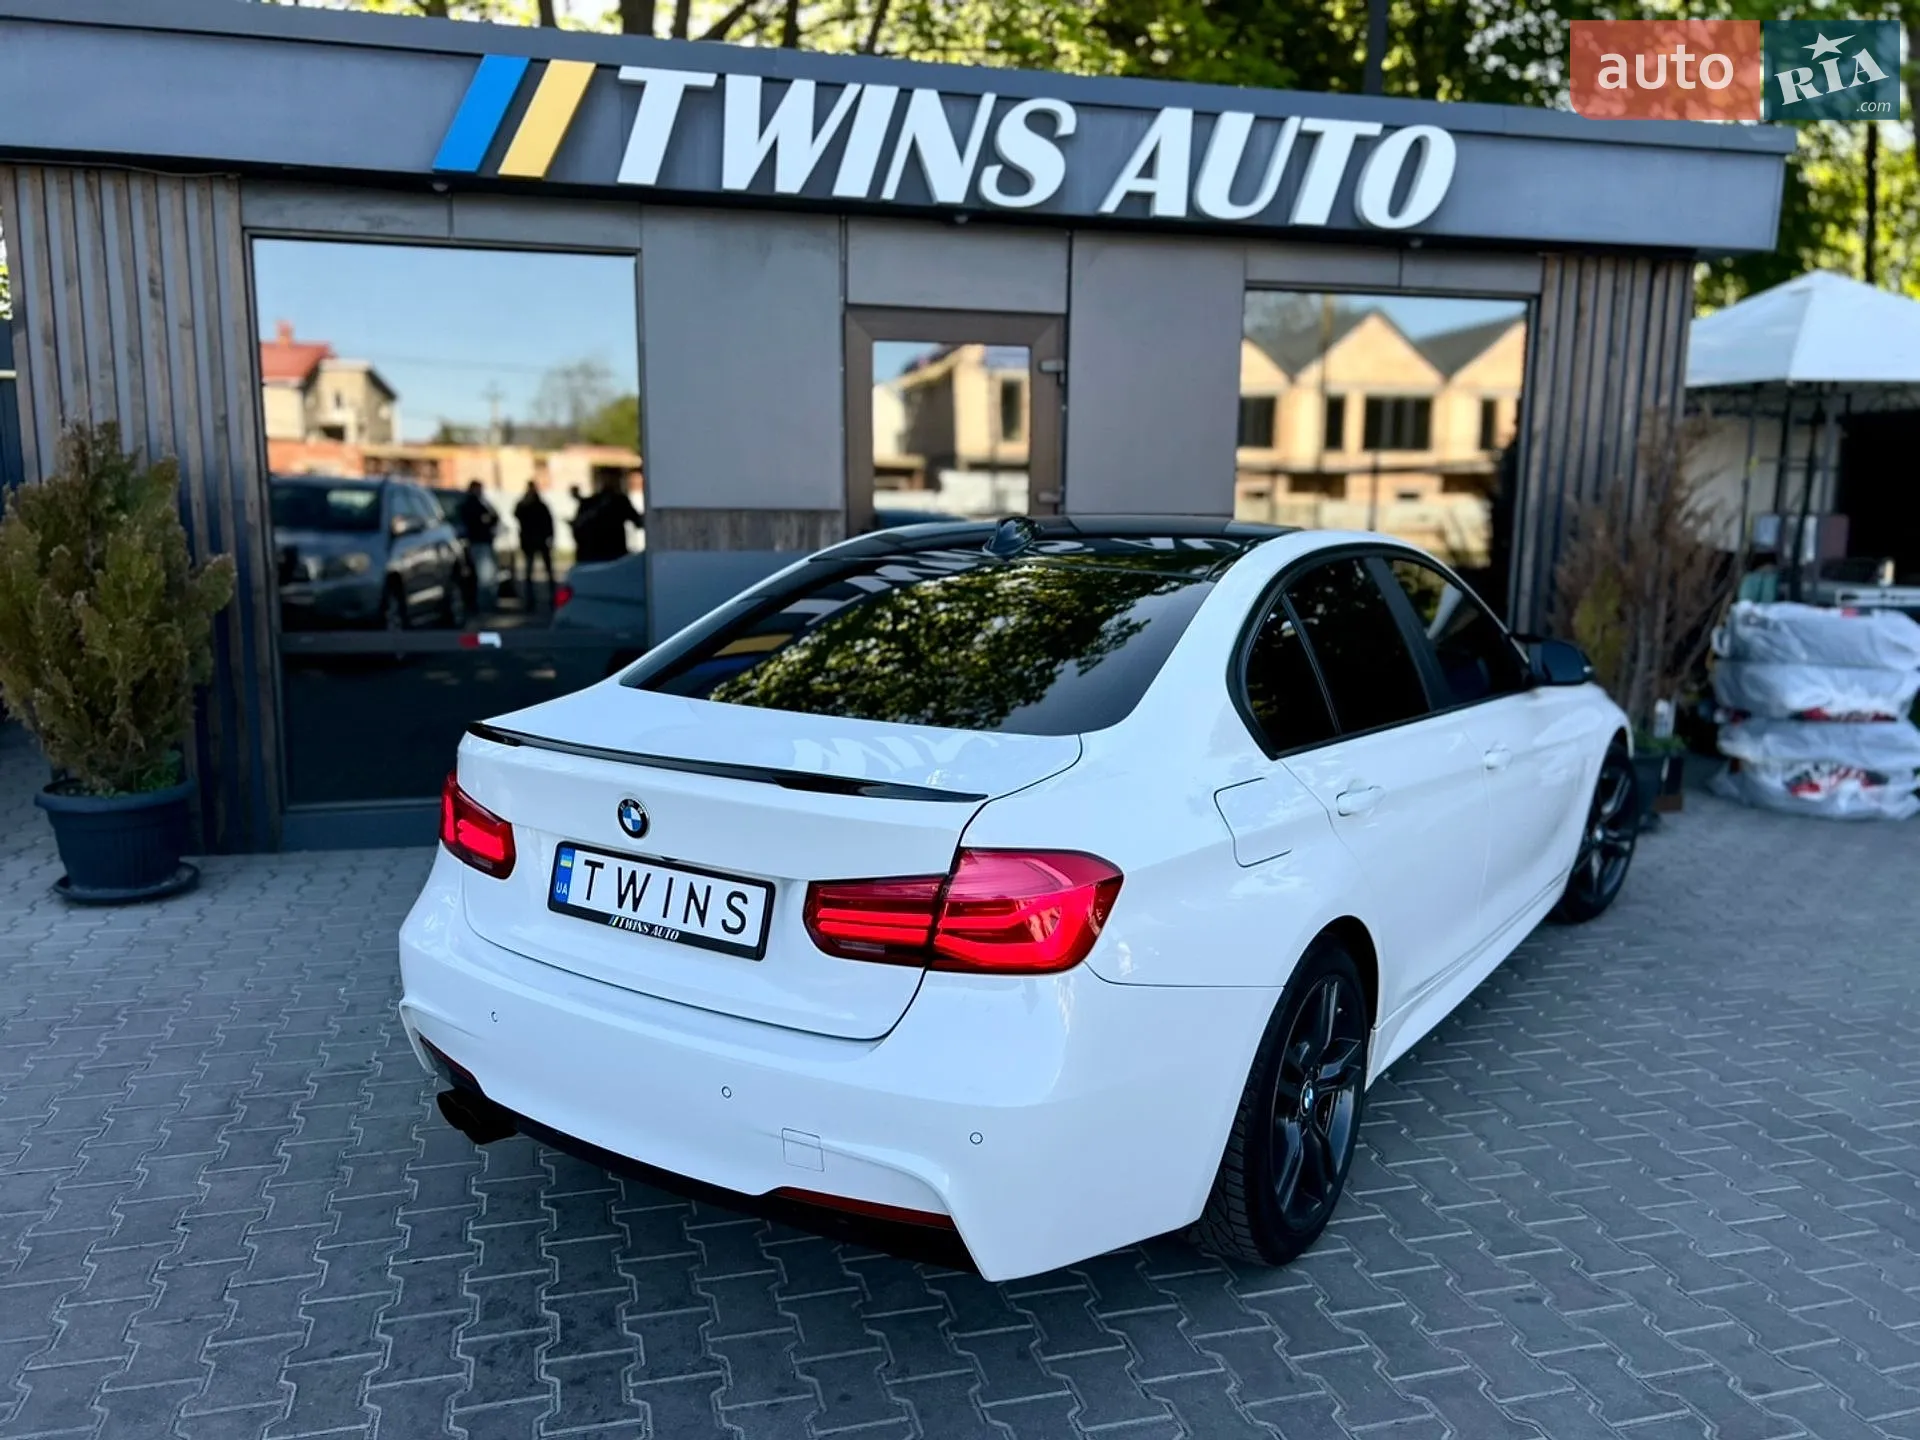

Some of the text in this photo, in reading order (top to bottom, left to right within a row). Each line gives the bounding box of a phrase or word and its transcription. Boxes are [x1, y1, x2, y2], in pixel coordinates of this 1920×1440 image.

[616, 65, 1458, 231] TWINS AUTO
[555, 881, 568, 896] UA
[583, 859, 749, 935] TWINS
[619, 917, 680, 940] TWINS AUTO
